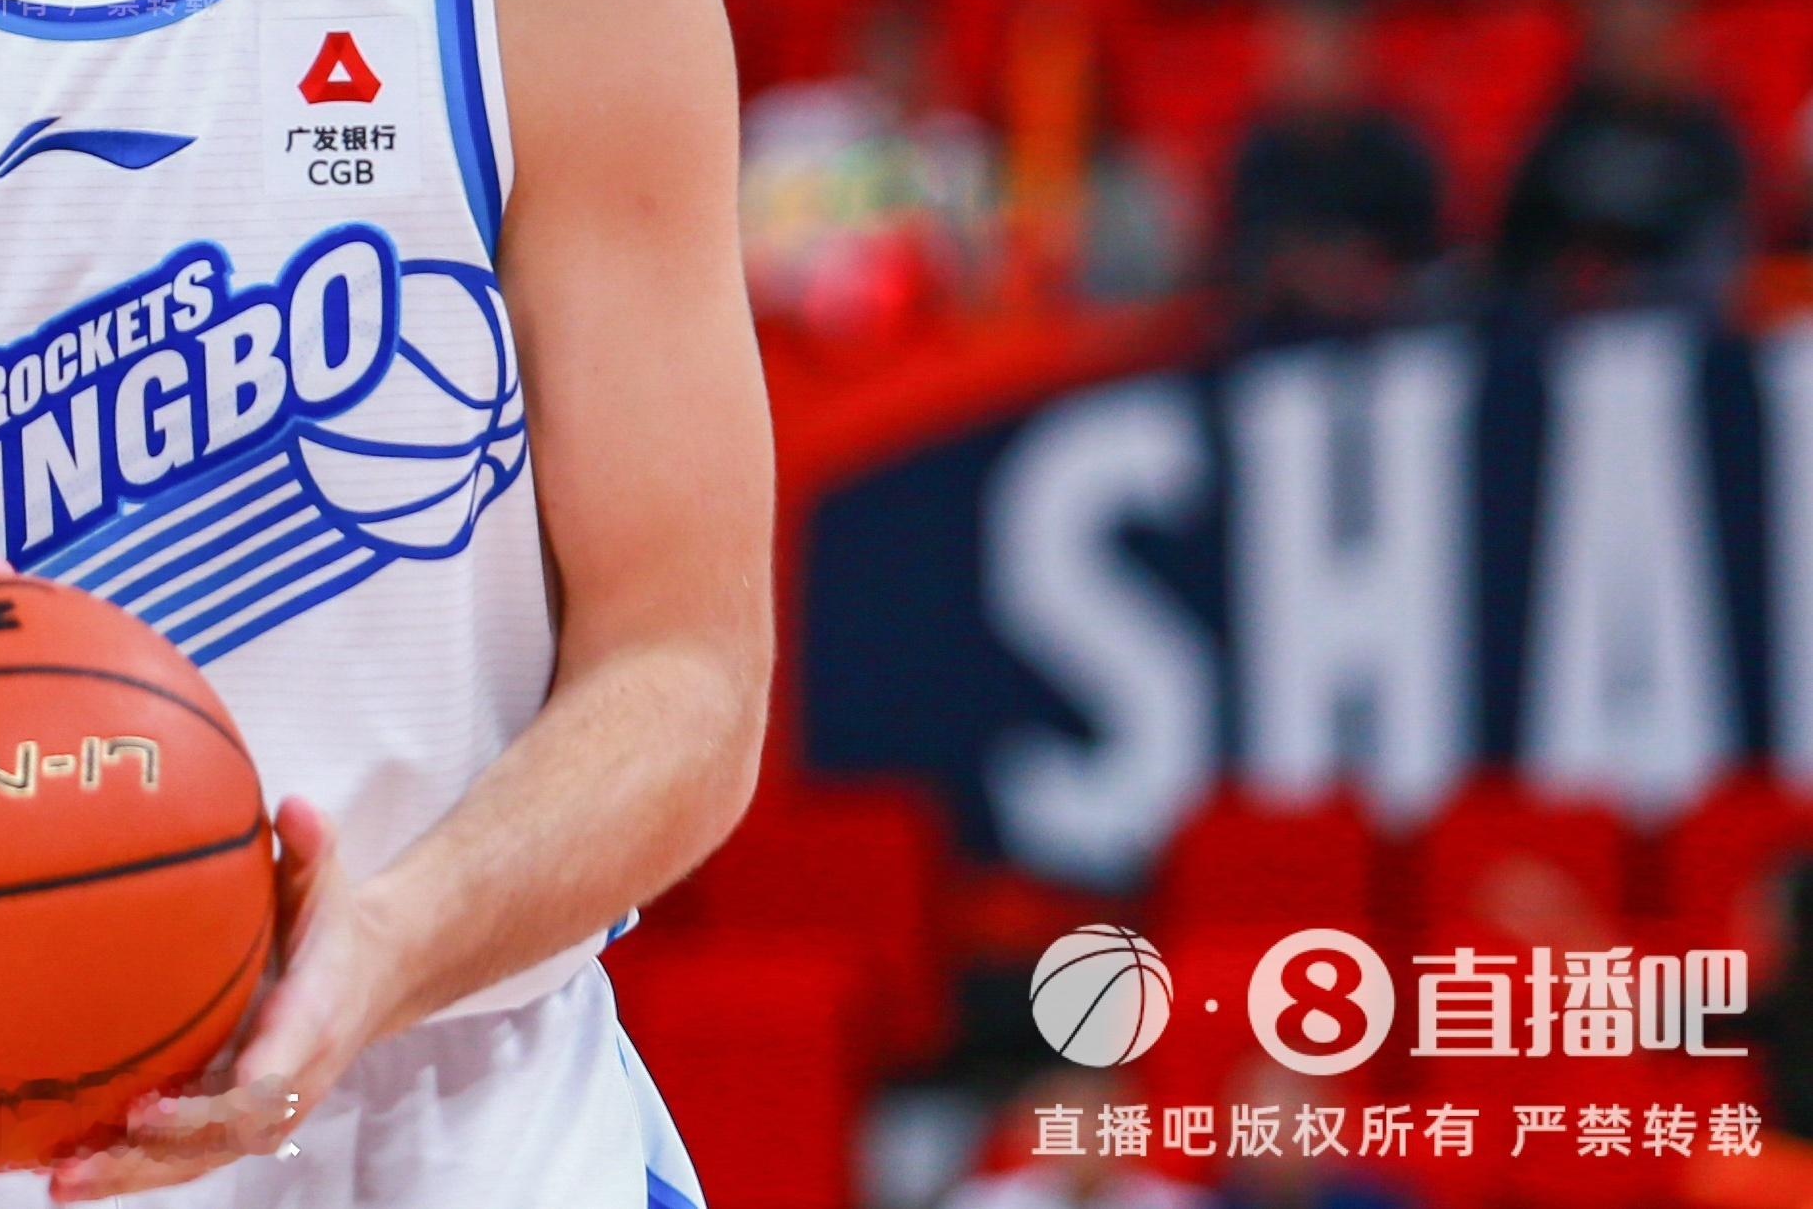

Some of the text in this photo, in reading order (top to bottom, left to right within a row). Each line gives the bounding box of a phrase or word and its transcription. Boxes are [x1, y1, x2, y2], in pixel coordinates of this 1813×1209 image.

[285, 124, 396, 153] 广发银行
[308, 159, 374, 186] CGB
[984, 315, 1813, 889] SHA
